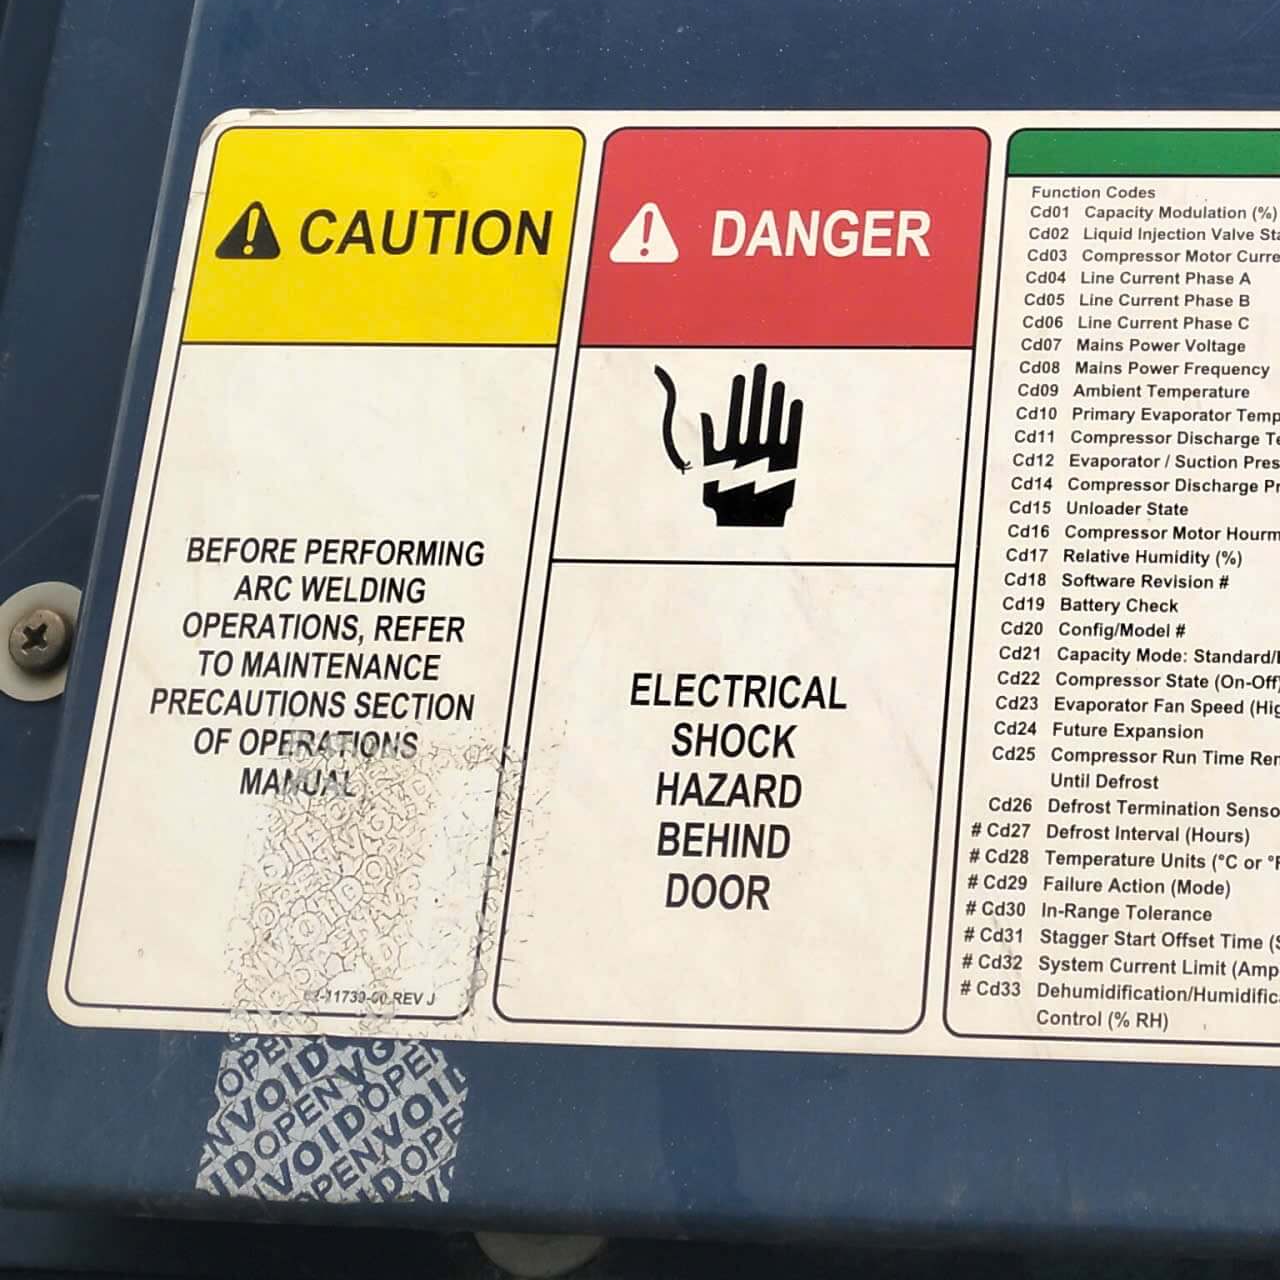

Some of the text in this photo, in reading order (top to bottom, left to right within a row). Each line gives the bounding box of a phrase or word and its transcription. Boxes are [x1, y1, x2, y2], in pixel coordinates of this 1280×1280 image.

[1031, 185, 1156, 199] Function Codes
[299, 208, 554, 256] CAUTION
[711, 209, 932, 258] DANGER
[1028, 226, 1070, 240] Cd02
[1083, 226, 1133, 244] Liquid
[1137, 226, 1206, 244] Injection
[1210, 227, 1255, 241] Valve
[1020, 337, 1246, 357] Cd07 Mains Power Voltage
[1014, 429, 1055, 444] Cd11
[1070, 429, 1173, 448] Compressor
[1176, 430, 1261, 449] Discharge
[185, 536, 486, 568] BEFORE PERFORMING
[232, 574, 427, 605] ARC WELDING
[1003, 571, 1047, 587] Cd18
[1061, 572, 1136, 589] Software
[1140, 573, 1214, 590] Revision
[182, 611, 466, 647] OPERATIONS, REFER
[198, 649, 442, 682] TO MAINTENANCE
[998, 645, 1041, 661] Cd21
[1056, 646, 1132, 666] Capacity
[1135, 647, 1188, 664] Mode:
[149, 687, 476, 722] PRECAUTIONS SECTION
[630, 673, 847, 709] ELECTRICAL
[193, 726, 233, 756] OF
[672, 722, 798, 759] SHOCK
[656, 772, 802, 808] HAZARD
[657, 822, 790, 859] BEHIND
[984, 847, 1030, 865] Cd28
[1044, 849, 1156, 870] Temperature
[1160, 851, 1207, 869] Units
[1243, 857, 1263, 871] or
[665, 873, 770, 910] DOOR
[392, 991, 424, 1006] REV
[426, 992, 436, 1007] J
